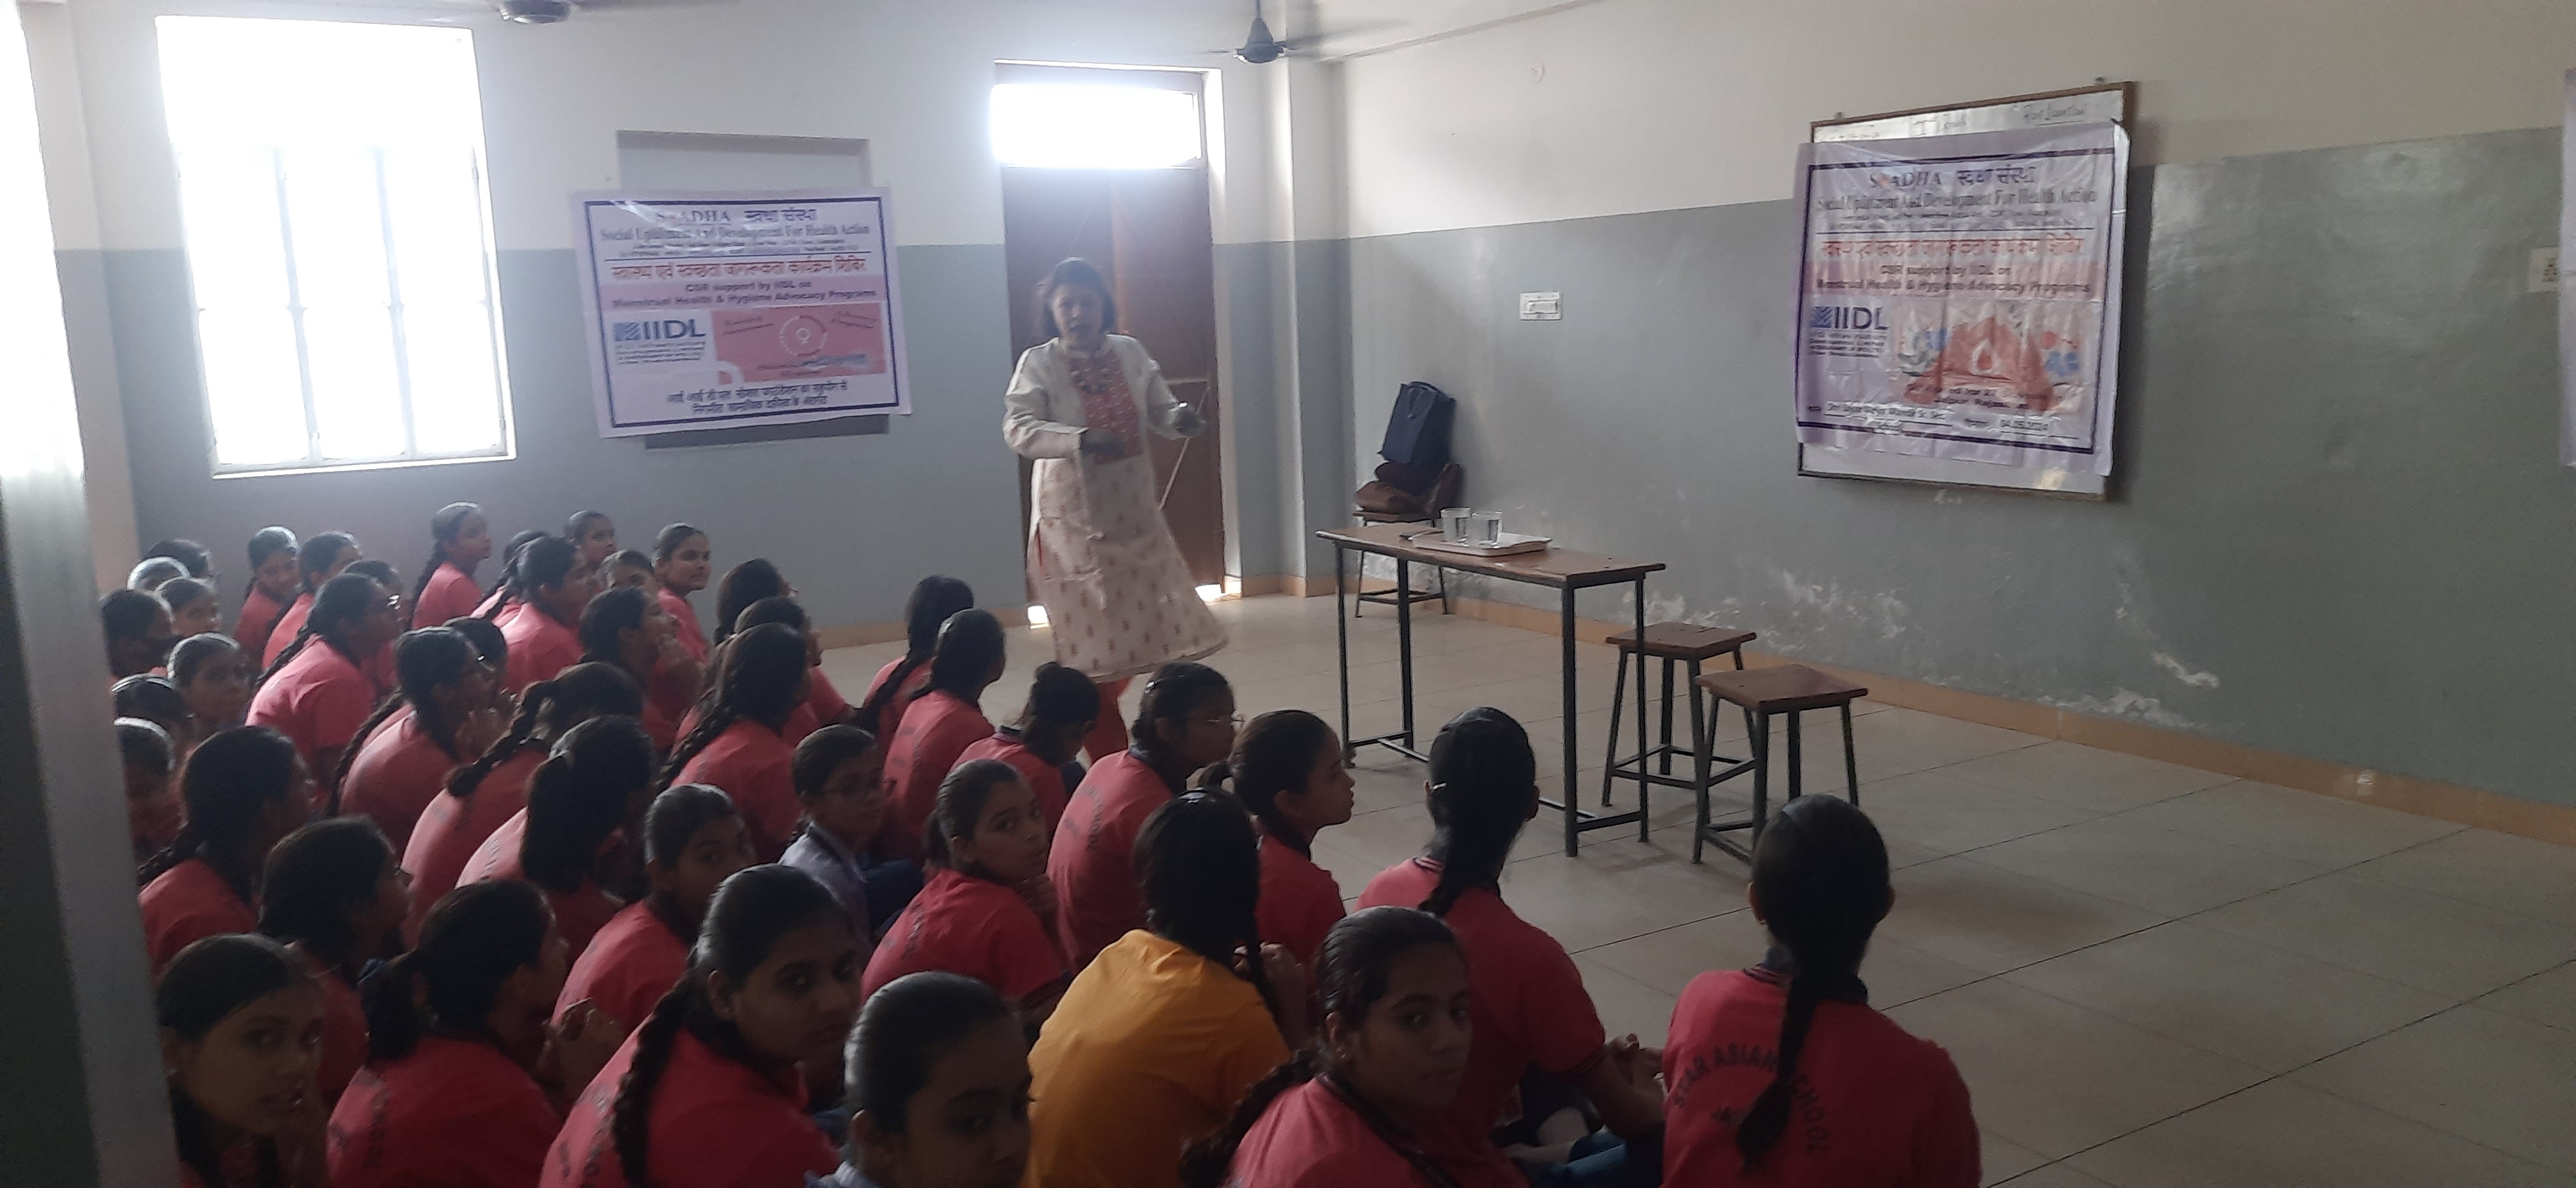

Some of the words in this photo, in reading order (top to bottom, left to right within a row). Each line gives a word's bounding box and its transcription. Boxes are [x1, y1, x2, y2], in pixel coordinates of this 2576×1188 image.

[757, 281, 770, 291] by
[1834, 306, 1889, 330] IIDL
[643, 319, 706, 340] IIDL
[1789, 1073, 1830, 1155] CHOOL
